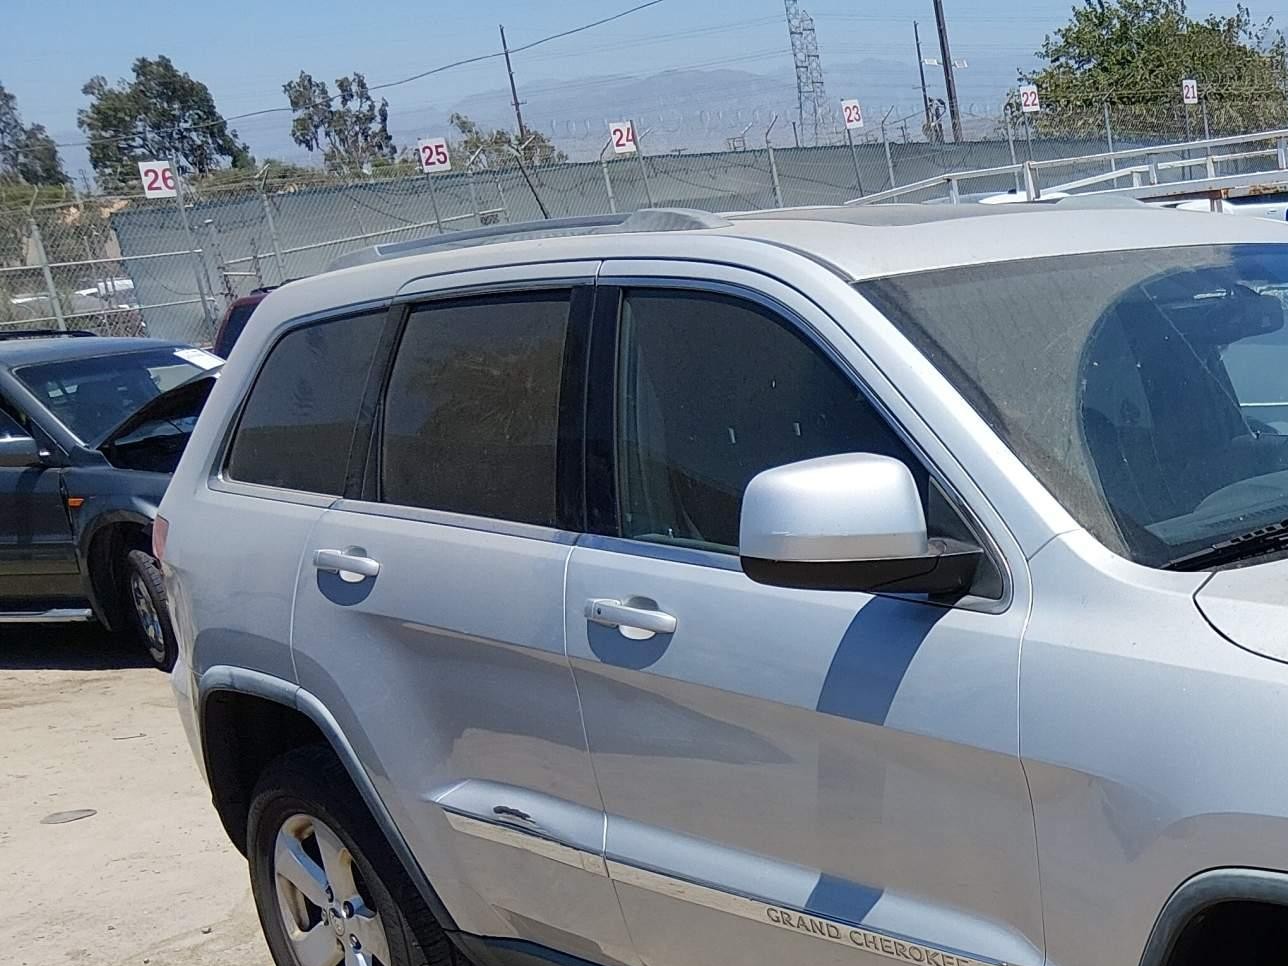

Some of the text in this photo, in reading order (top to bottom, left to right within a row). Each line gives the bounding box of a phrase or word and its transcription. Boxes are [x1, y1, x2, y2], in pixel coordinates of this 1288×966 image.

[1022, 91, 1038, 107] 22
[1184, 84, 1196, 99] 21
[844, 105, 861, 123] 23
[613, 127, 635, 148] 24
[422, 144, 448, 166] 25
[144, 168, 177, 191] 26
[766, 907, 842, 940] GRAND
